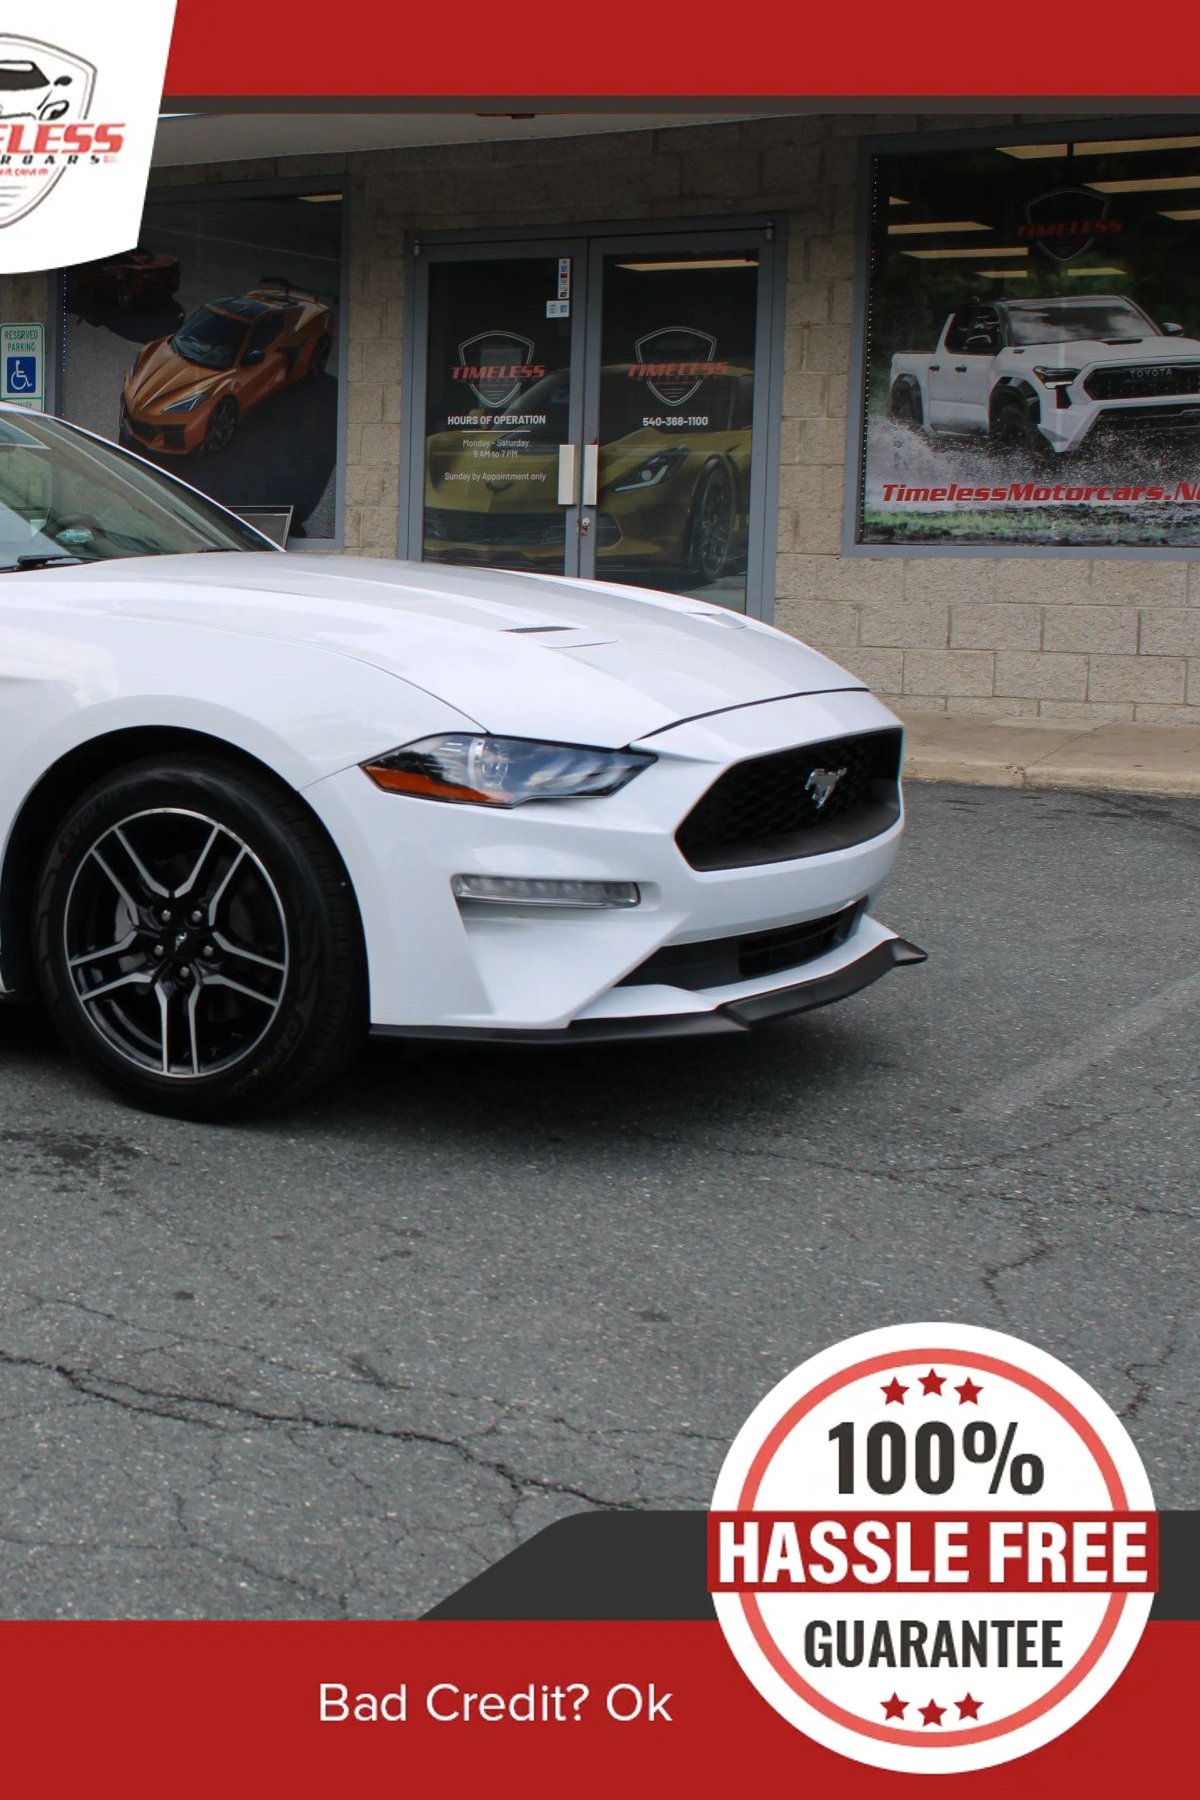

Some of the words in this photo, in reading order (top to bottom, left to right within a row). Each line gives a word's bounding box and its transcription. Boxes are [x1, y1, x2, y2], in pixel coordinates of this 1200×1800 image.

[5, 330, 38, 340] RESERVED
[8, 342, 35, 352] PARKING
[451, 364, 545, 379] TIMELESS
[627, 361, 729, 377] TIMELESS
[1129, 368, 1173, 378] TOYOTA
[447, 416, 479, 425] HOURS
[480, 416, 492, 425] OF
[494, 415, 546, 425] OPERATION
[642, 416, 709, 427] 540-368-1100
[462, 439, 490, 450] Monday
[496, 439, 530, 451] Saturday
[480, 450, 490, 458] AM
[492, 450, 500, 458] to
[500, 450, 505, 458] 7
[506, 450, 518, 458] PM
[444, 472, 471, 482] Sunday
[472, 472, 480, 482] by
[482, 472, 529, 482] Appointment
[530, 472, 547, 482] only
